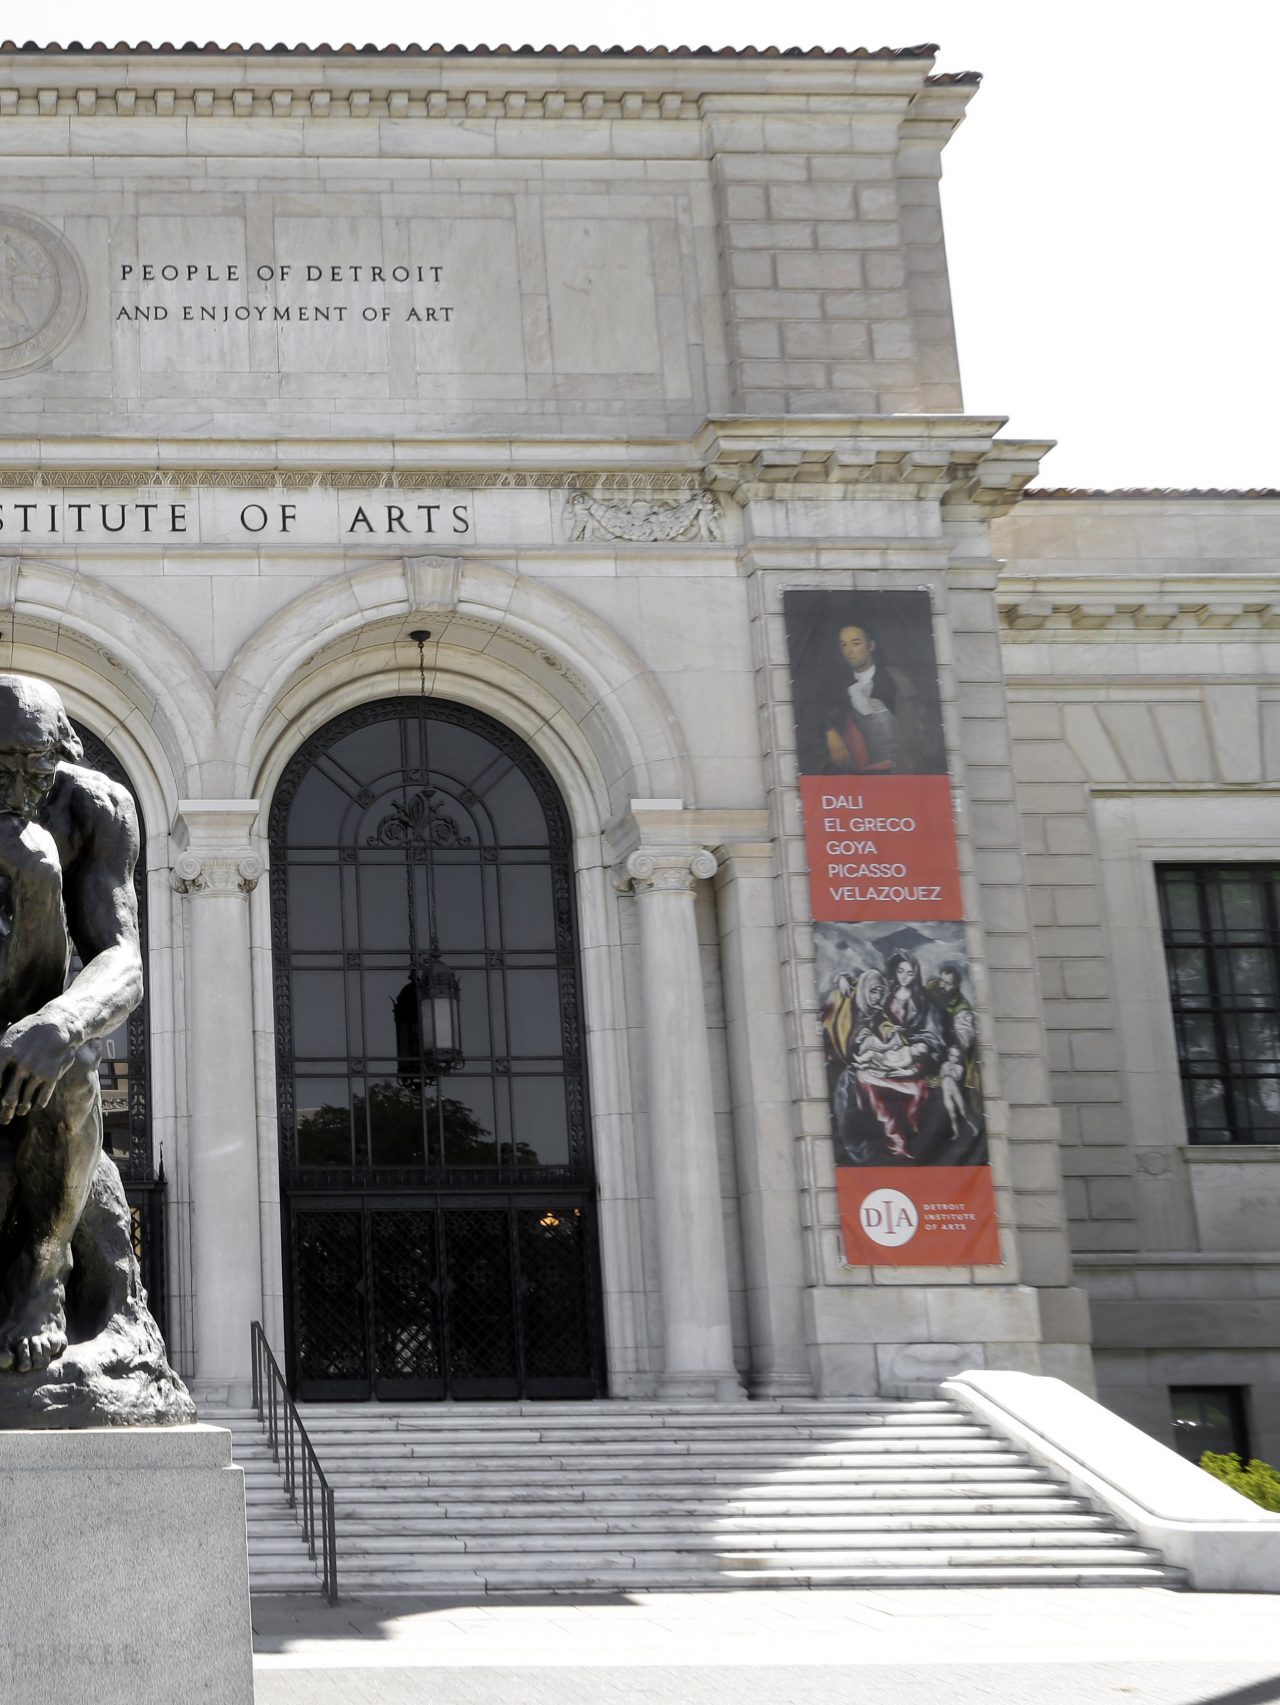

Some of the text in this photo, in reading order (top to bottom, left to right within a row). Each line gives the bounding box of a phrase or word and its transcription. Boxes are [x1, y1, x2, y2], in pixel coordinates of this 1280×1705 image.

[120, 264, 444, 283] PEOPLE OF DETROIT
[115, 305, 455, 323] AND ENJOYMENT OF ART
[239, 502, 298, 533] OF
[346, 503, 471, 534] ARTS
[821, 794, 864, 810] DALI
[823, 817, 916, 832] EL GRECO
[825, 840, 878, 855] GOYA
[827, 863, 907, 878] PICASSO
[829, 886, 943, 902] VELAZQUEZ
[923, 1203, 966, 1211] DETROIT
[862, 1200, 915, 1235] DIA
[924, 1213, 976, 1221] INSTITUTE
[925, 1223, 967, 1231] OF ARTS
